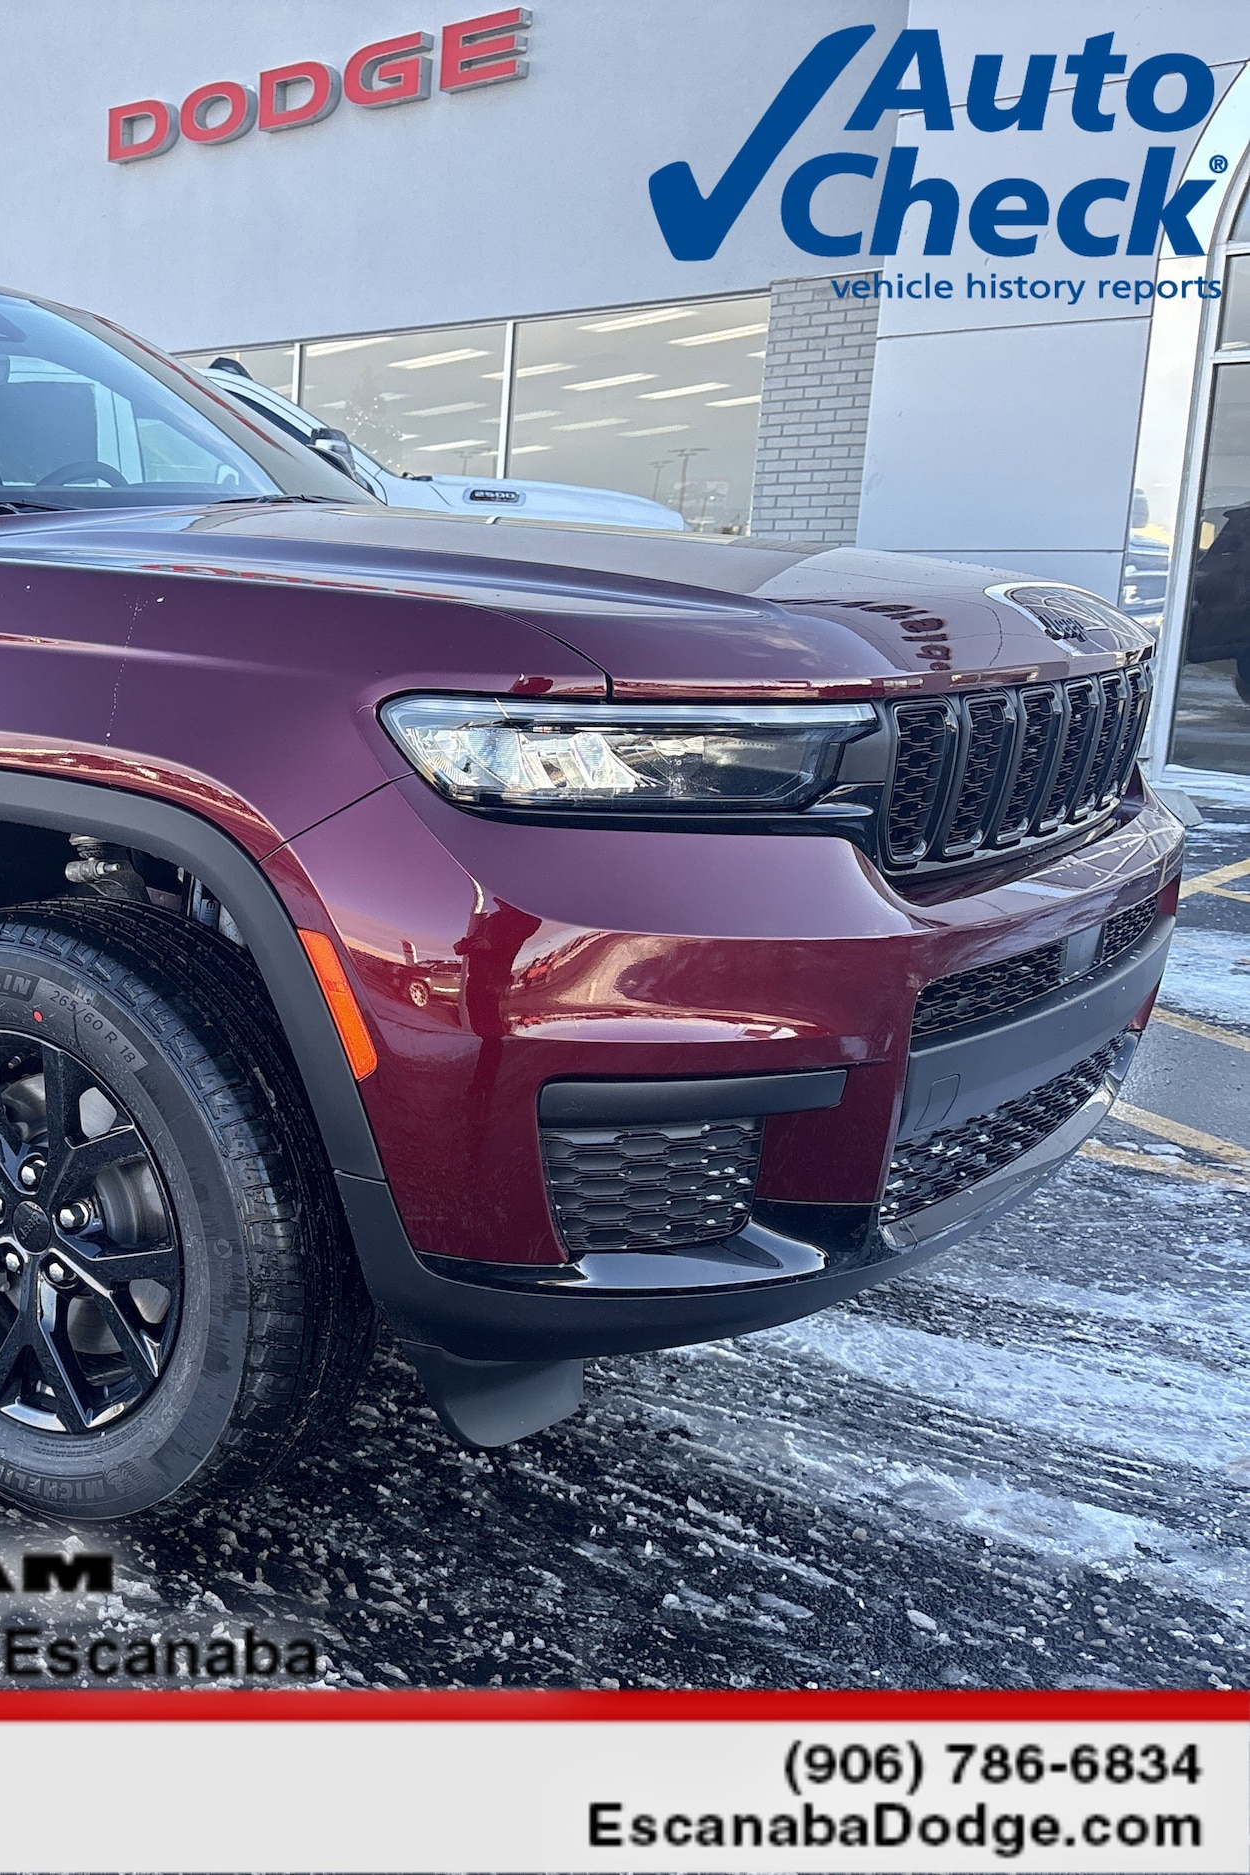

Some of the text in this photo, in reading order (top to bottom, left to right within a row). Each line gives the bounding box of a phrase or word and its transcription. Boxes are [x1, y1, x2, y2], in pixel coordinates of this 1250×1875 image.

[107, 7, 533, 166] DODGE
[50, 988, 137, 1064] 265/60 R 18
